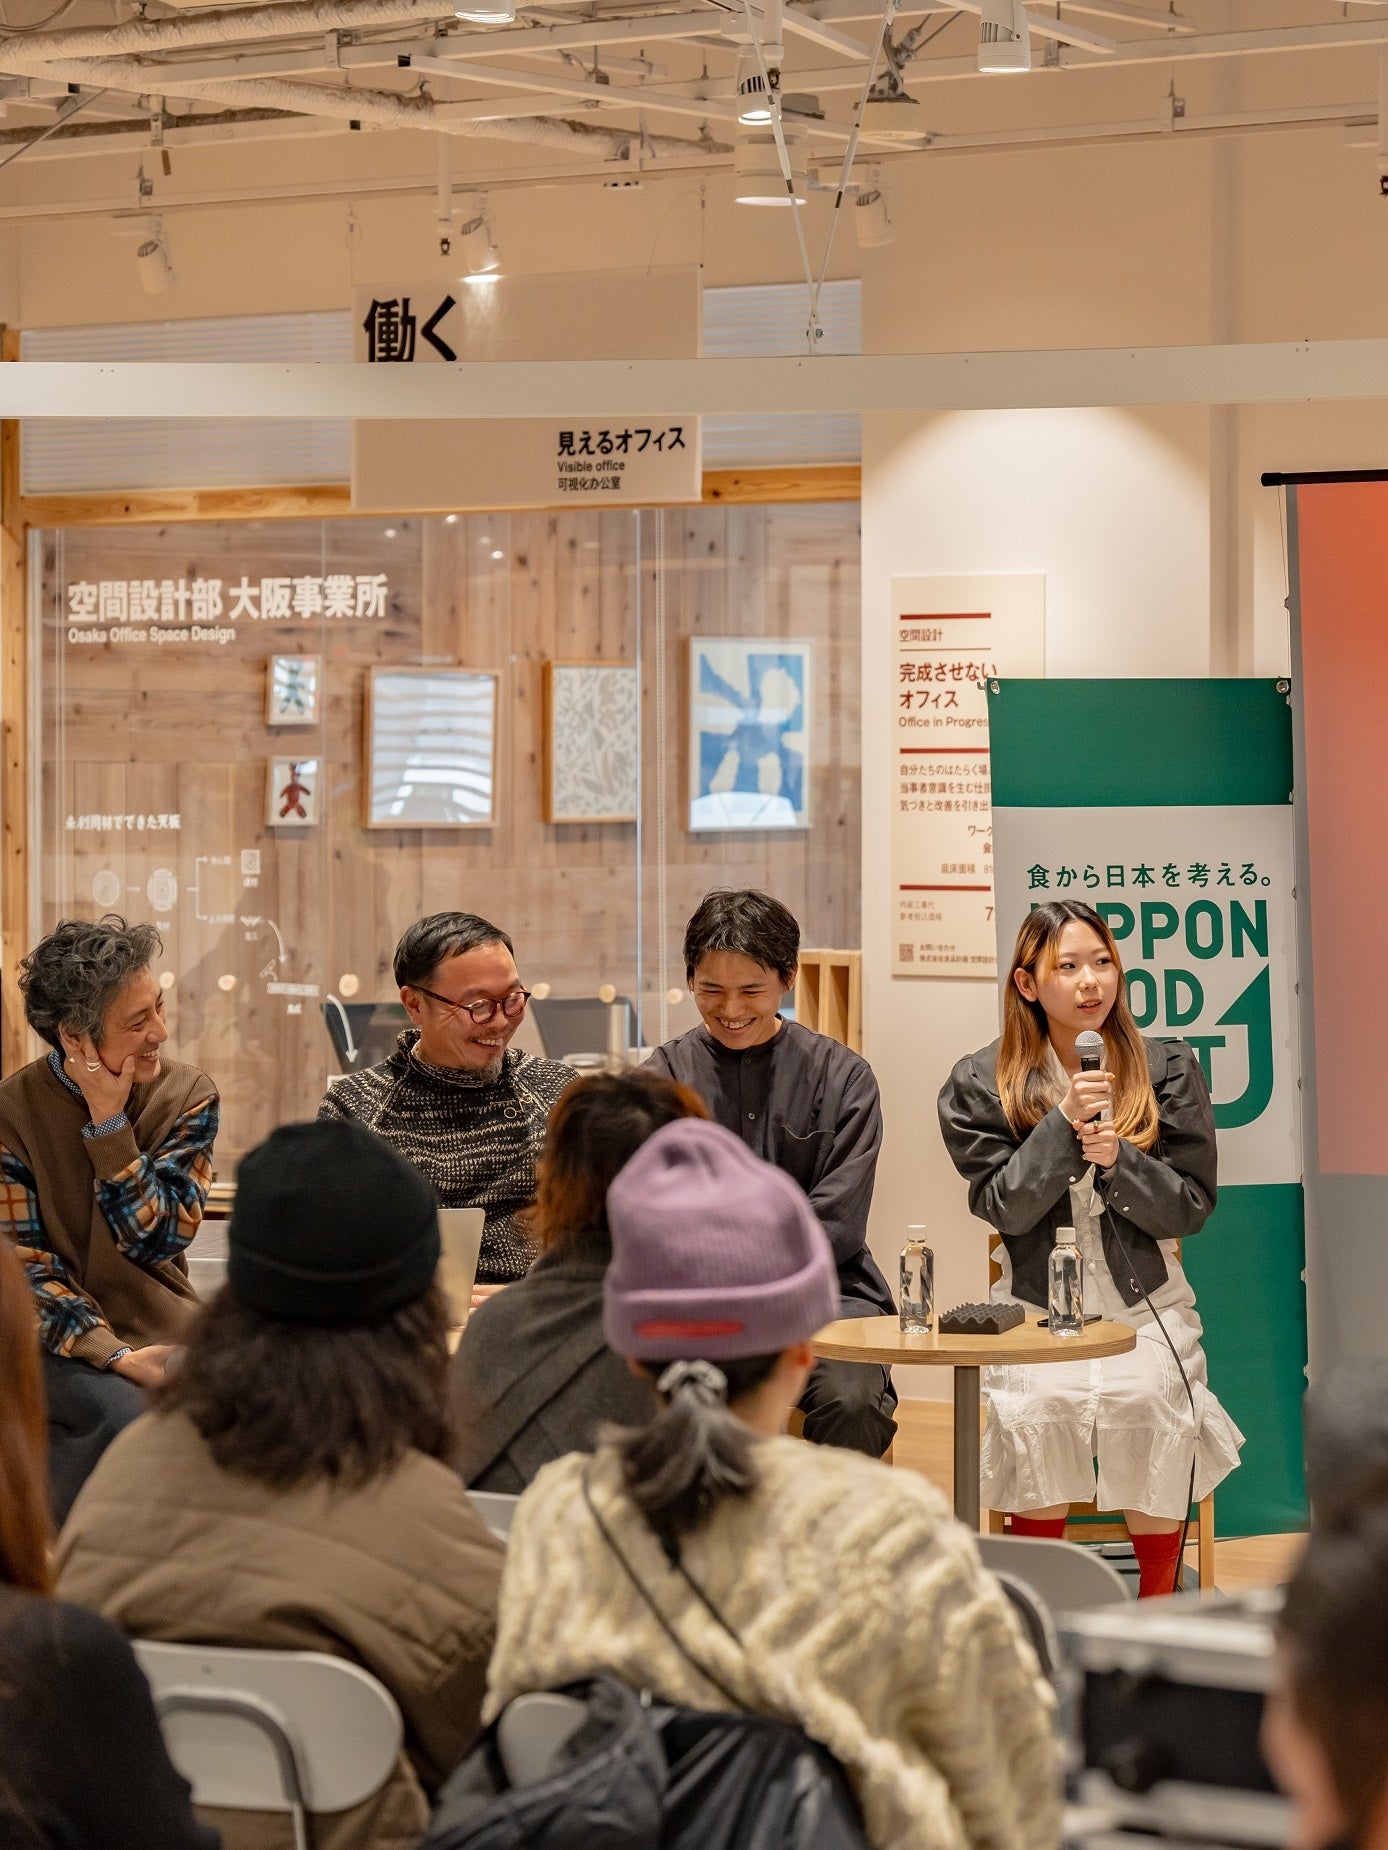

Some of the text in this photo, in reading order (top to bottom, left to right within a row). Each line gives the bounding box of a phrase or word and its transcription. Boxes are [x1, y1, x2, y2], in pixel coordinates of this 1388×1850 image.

[363, 294, 457, 362] 働く
[557, 426, 686, 457] 見えるオフィス
[557, 459, 626, 472] Visible office
[67, 574, 388, 622] 空間設計部 大阪事業所
[68, 625, 236, 645] Osaka Office Space Design
[899, 629, 943, 642] 空間設計
[900, 662, 998, 683] 完成させない
[900, 689, 960, 709] オフィス
[898, 716, 988, 728] Office in Progres
[900, 764, 988, 776] 自分たちのはたらく場
[900, 799, 989, 812] 気づきと改善を引き出
[1027, 862, 1271, 889] 食から日本を考える。
[1030, 900, 1270, 960] PPON
[1124, 968, 1204, 1028] OD
